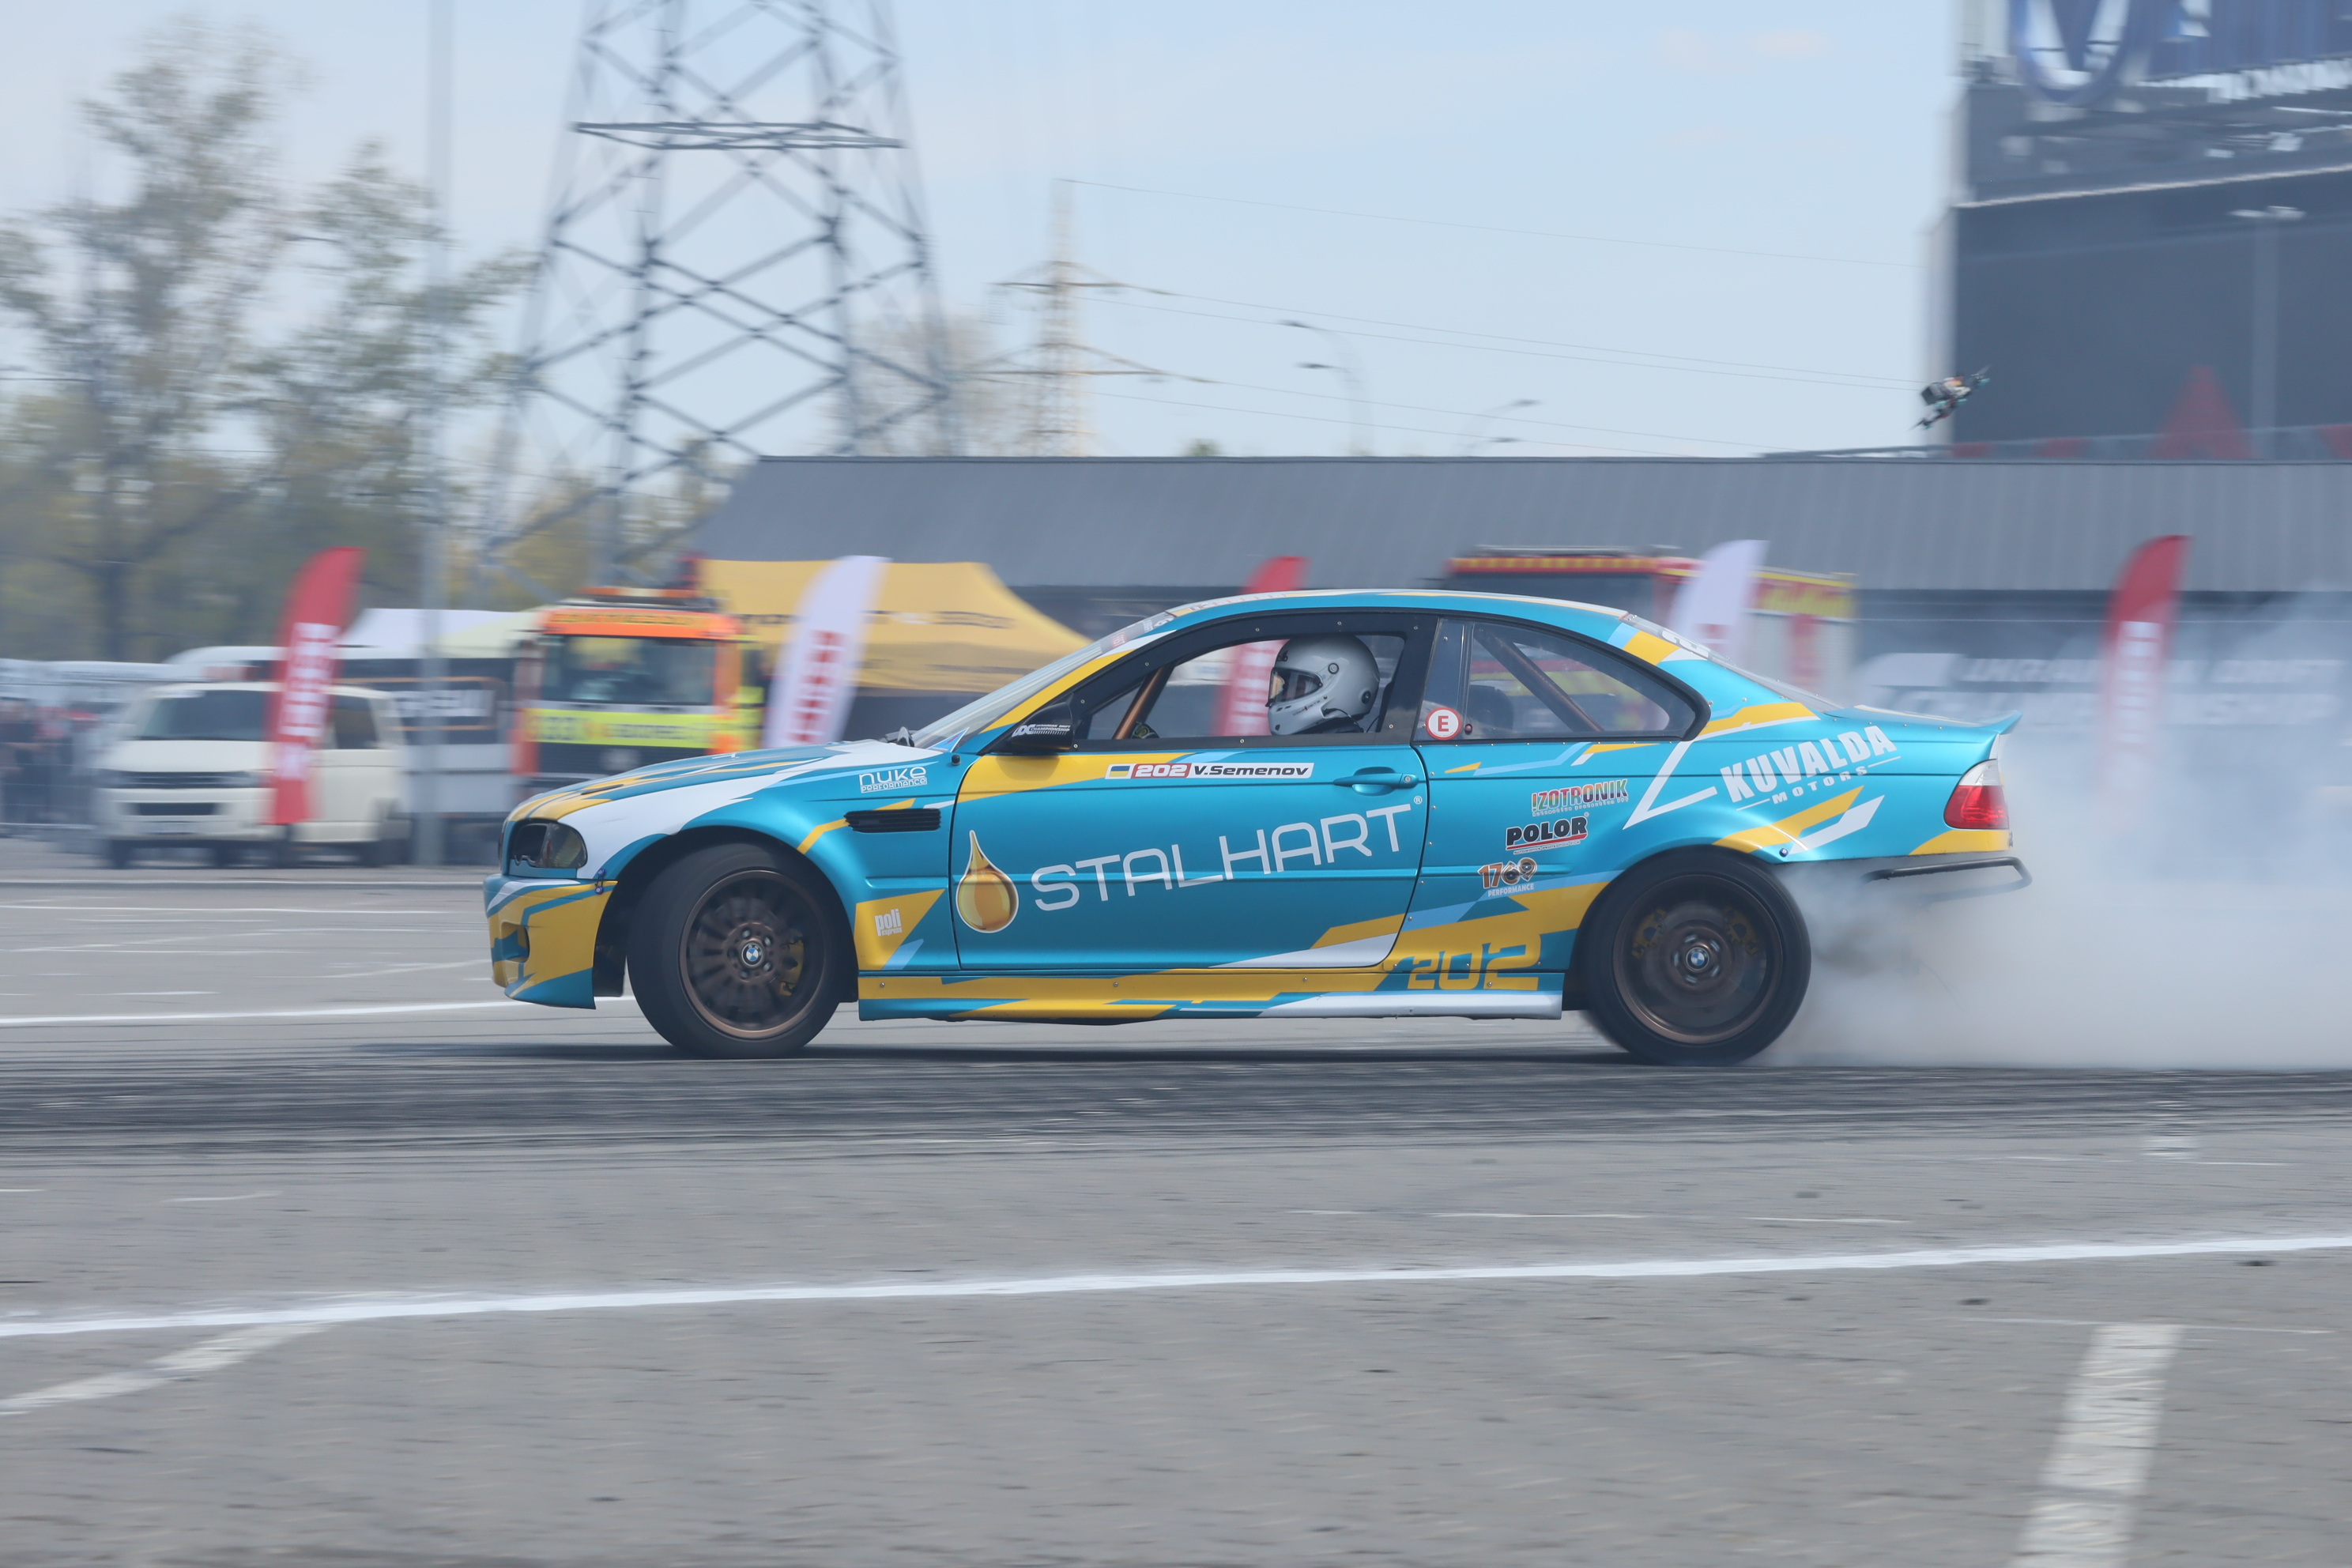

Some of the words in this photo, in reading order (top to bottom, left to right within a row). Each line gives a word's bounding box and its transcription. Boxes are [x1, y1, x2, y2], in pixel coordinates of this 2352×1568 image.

[1438, 715, 1449, 732] E
[1135, 764, 1187, 777] 202
[1194, 765, 1310, 776] V.Semenov
[1720, 726, 1897, 803] KUVALDA
[1772, 766, 1868, 805] MOTORS
[1506, 816, 1588, 846] POLOR
[1031, 803, 1412, 911] STALHART
[1478, 858, 1537, 889] 1769
[1488, 883, 1535, 898] PERFORMANCE
[875, 908, 902, 937] poli
[1408, 934, 1541, 991] 202
